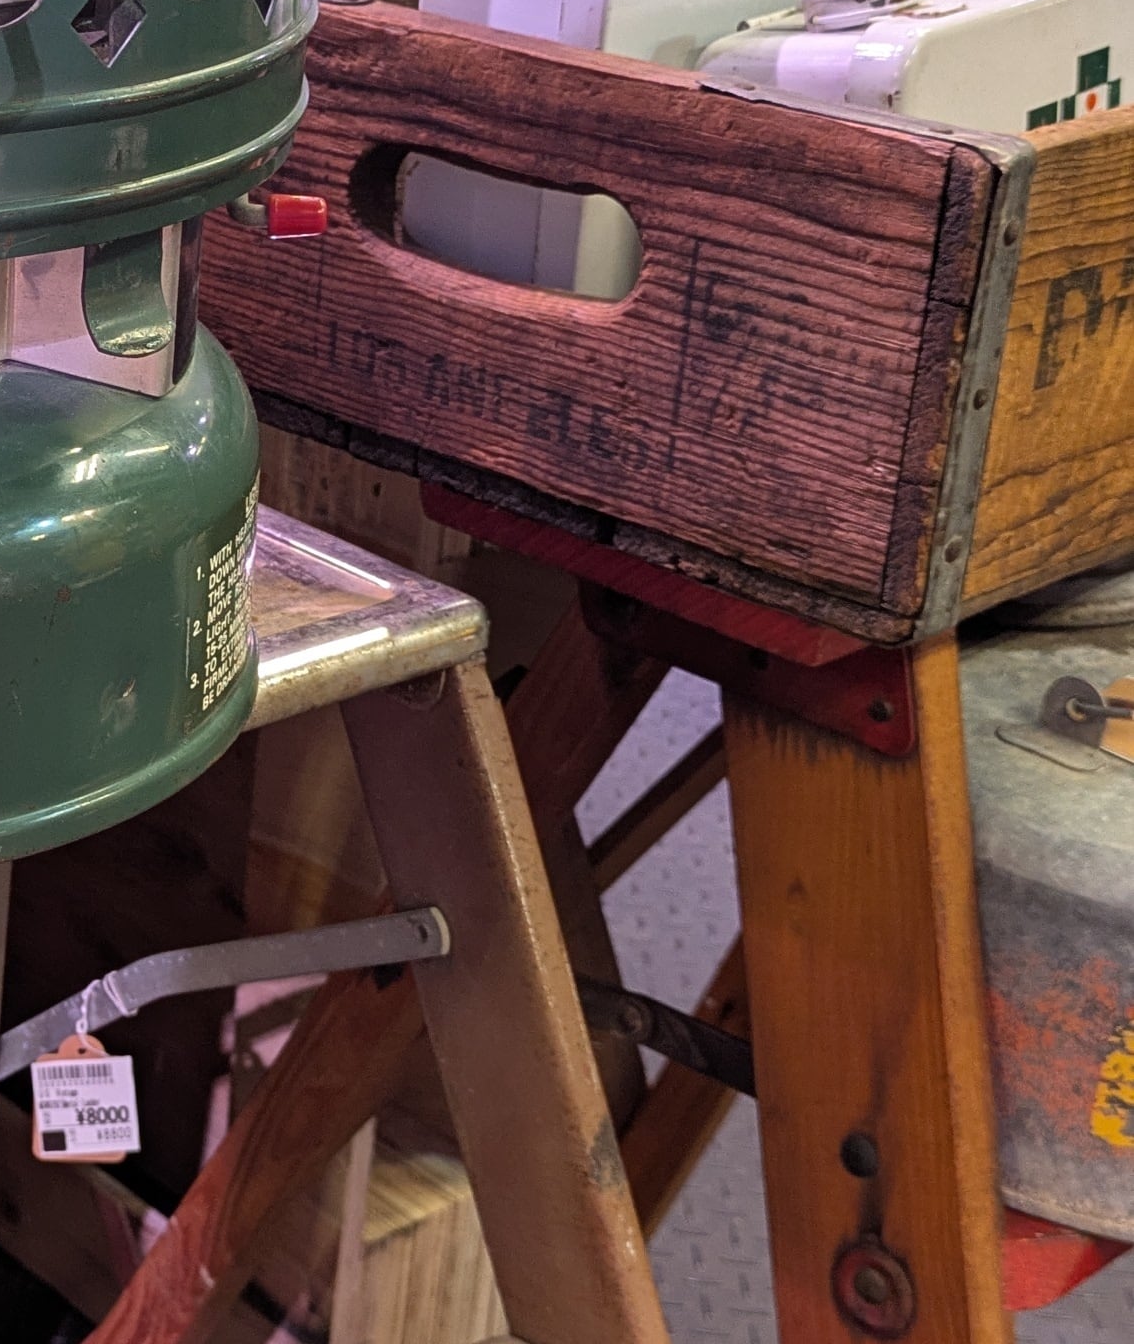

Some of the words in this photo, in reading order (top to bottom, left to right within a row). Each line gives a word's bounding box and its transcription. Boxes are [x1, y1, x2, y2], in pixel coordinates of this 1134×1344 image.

[209, 540, 233, 572] WITH
[209, 554, 236, 590] DOWN
[207, 590, 232, 625] MOVE
[208, 580, 226, 607] THE
[203, 656, 233, 694] FIRMLY
[204, 657, 217, 676] TO
[202, 689, 214, 711] BE
[76, 1105, 130, 1126] ¥8000
